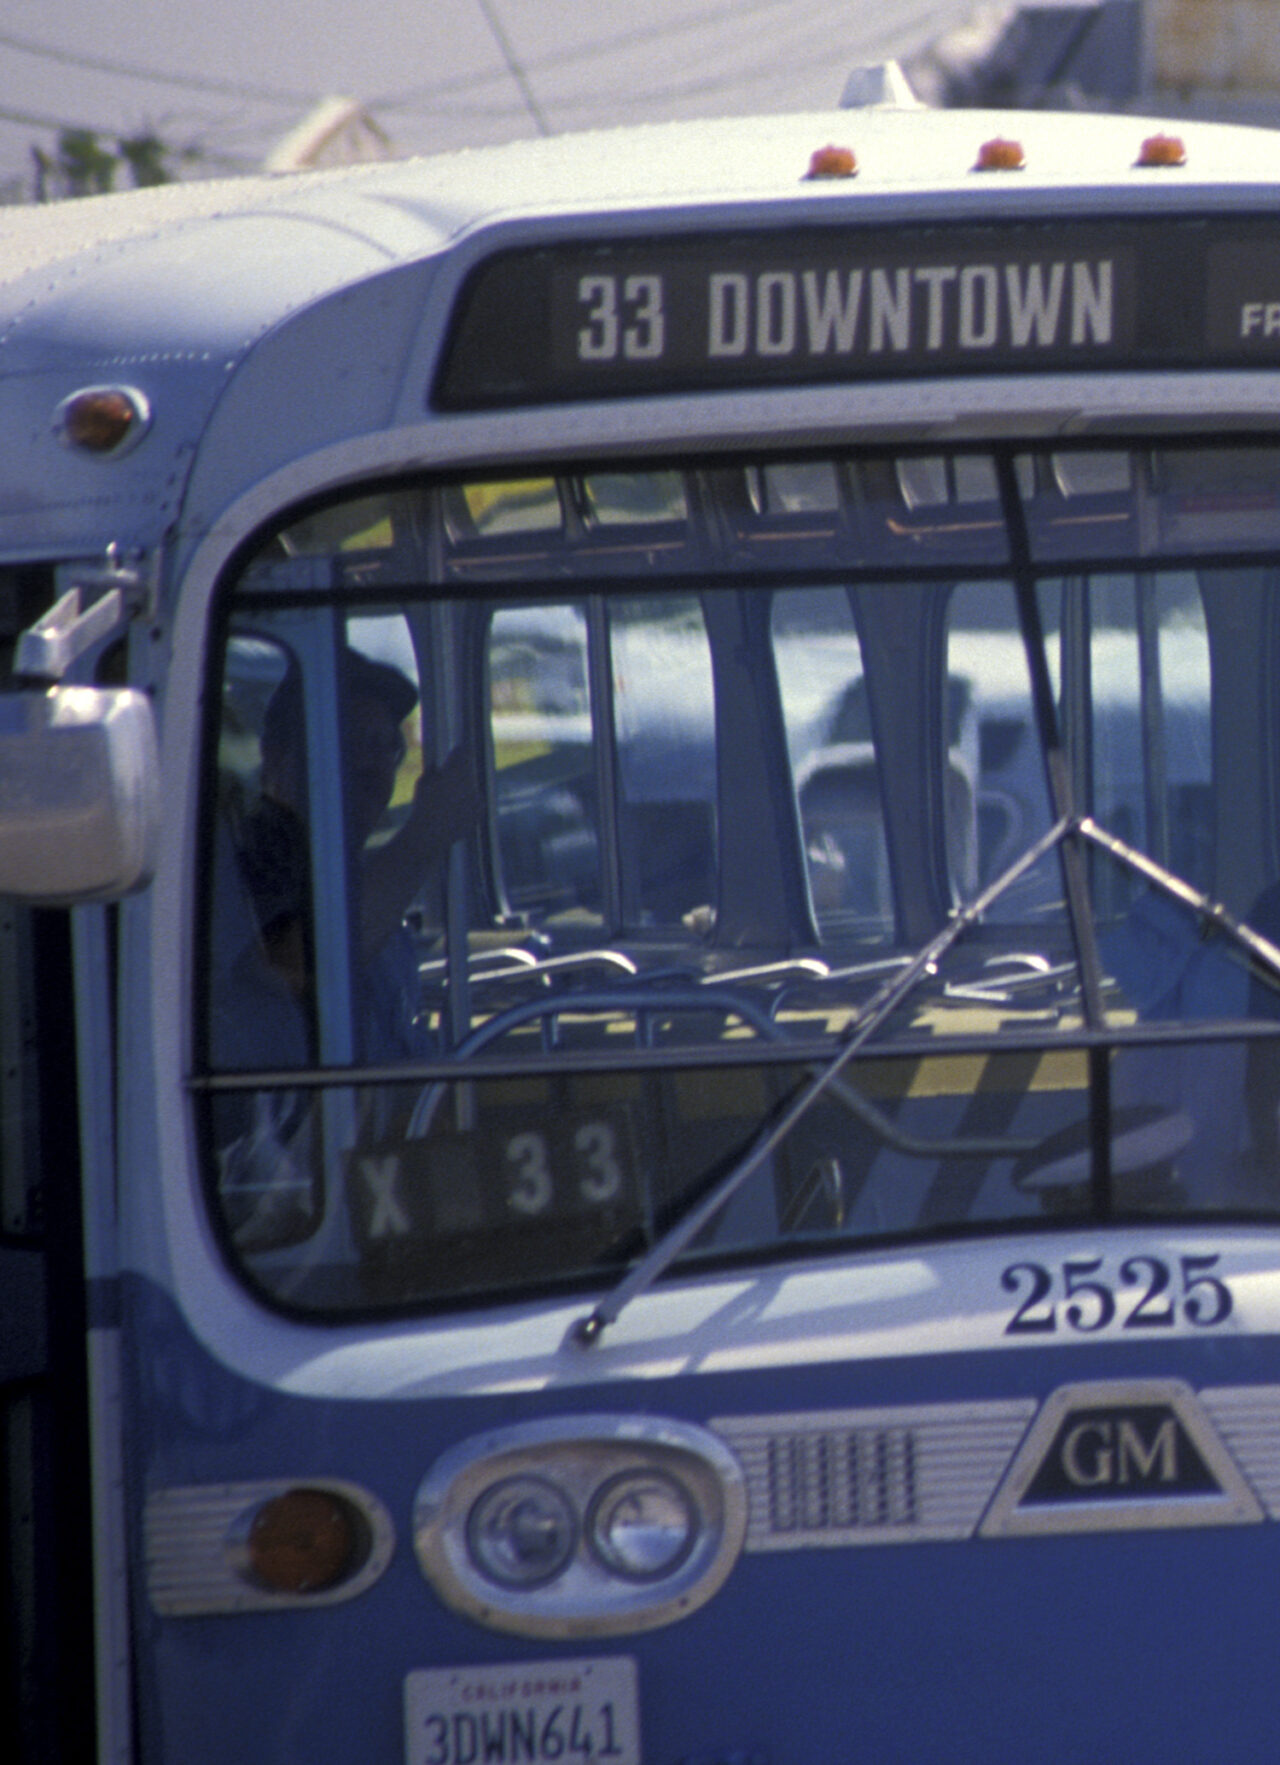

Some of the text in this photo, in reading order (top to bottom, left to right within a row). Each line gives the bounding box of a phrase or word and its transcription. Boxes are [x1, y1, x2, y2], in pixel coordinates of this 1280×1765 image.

[578, 259, 1114, 360] 33 DOWNTOWN
[359, 1156, 410, 1238] X
[1001, 1253, 1233, 1335] 2525
[1062, 1419, 1178, 1486] GM
[461, 1677, 582, 1701] CALIFORNIA
[424, 1702, 622, 1765] 3DWN641
